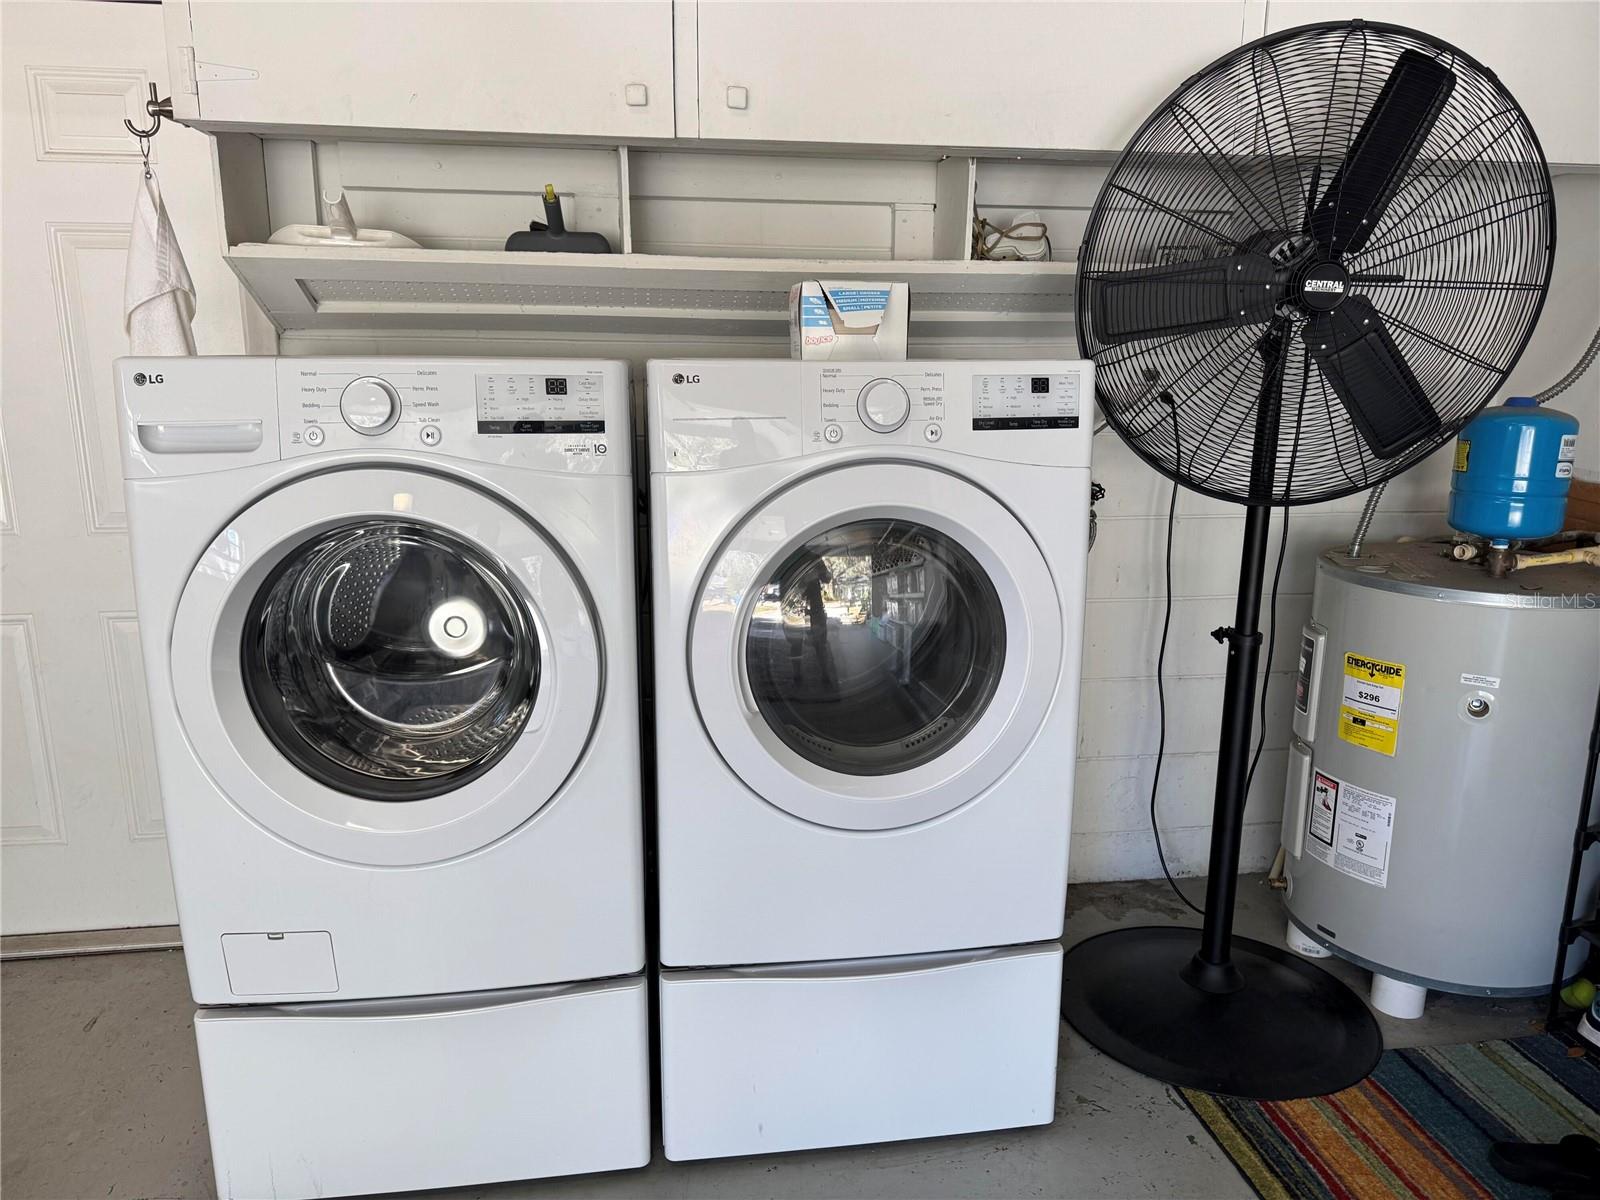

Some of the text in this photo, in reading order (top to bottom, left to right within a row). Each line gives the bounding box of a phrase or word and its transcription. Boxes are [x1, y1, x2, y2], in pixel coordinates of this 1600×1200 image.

[1305, 280, 1344, 288] CENTRAL
[148, 374, 164, 384] LG
[686, 374, 700, 384] LG
[1346, 656, 1402, 677] ENERGYGUIDE
[1358, 691, 1381, 703] $296
